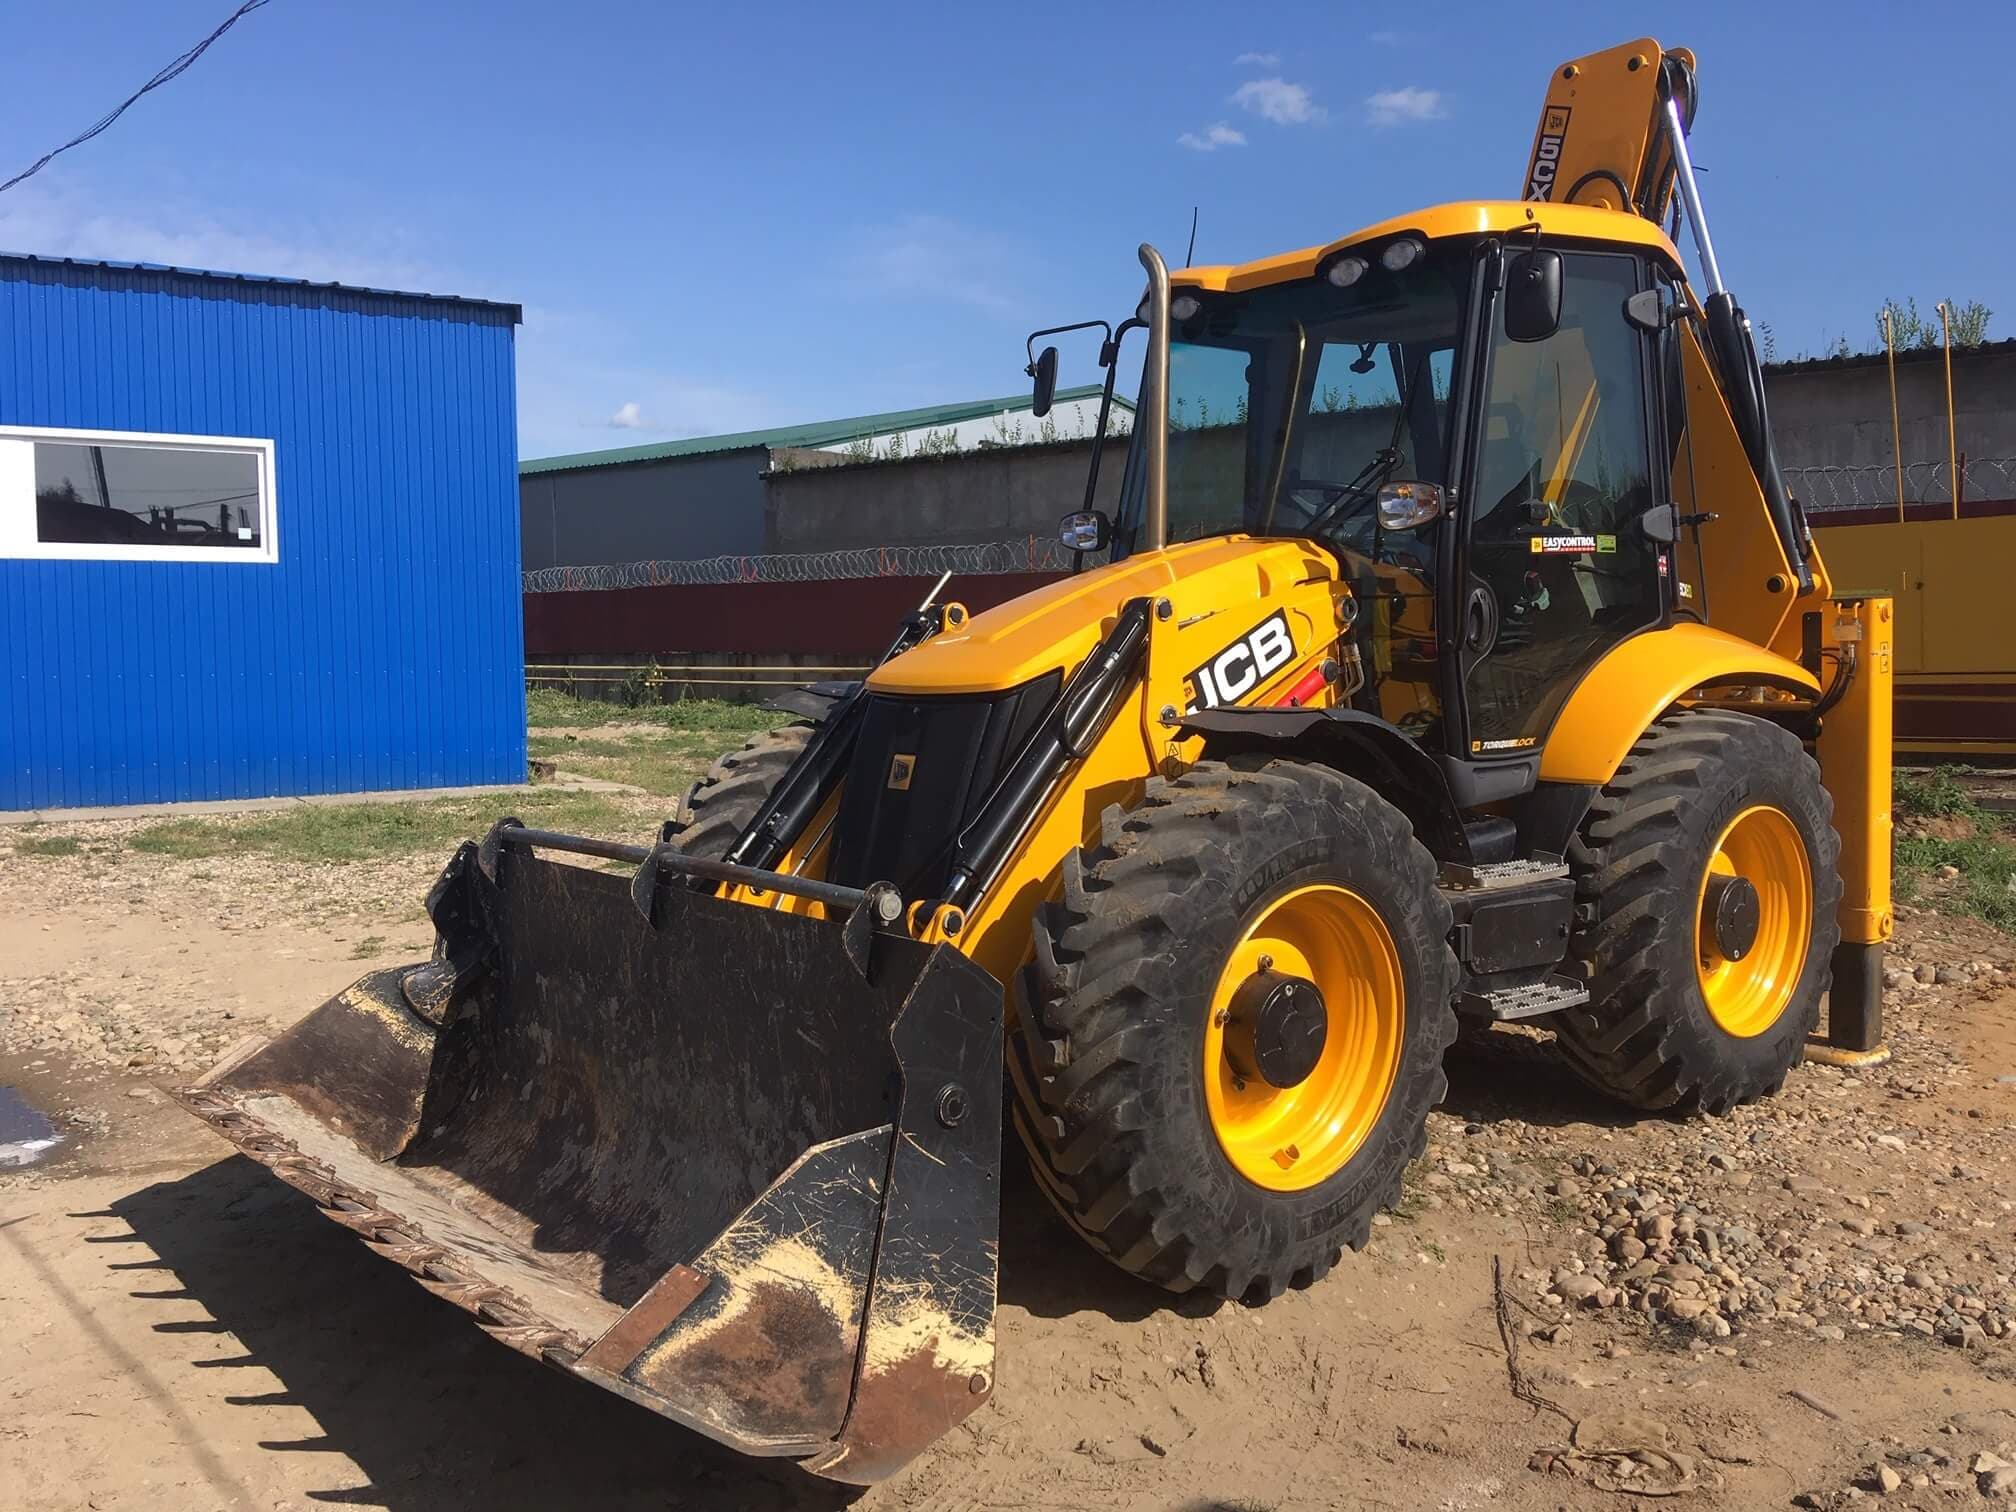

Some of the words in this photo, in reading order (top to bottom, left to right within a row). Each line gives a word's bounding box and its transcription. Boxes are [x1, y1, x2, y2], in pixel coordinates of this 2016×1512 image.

[1528, 137, 1561, 201] 5CX
[1543, 536, 1596, 551] EASYCONTROL
[1186, 617, 1292, 716] JCB
